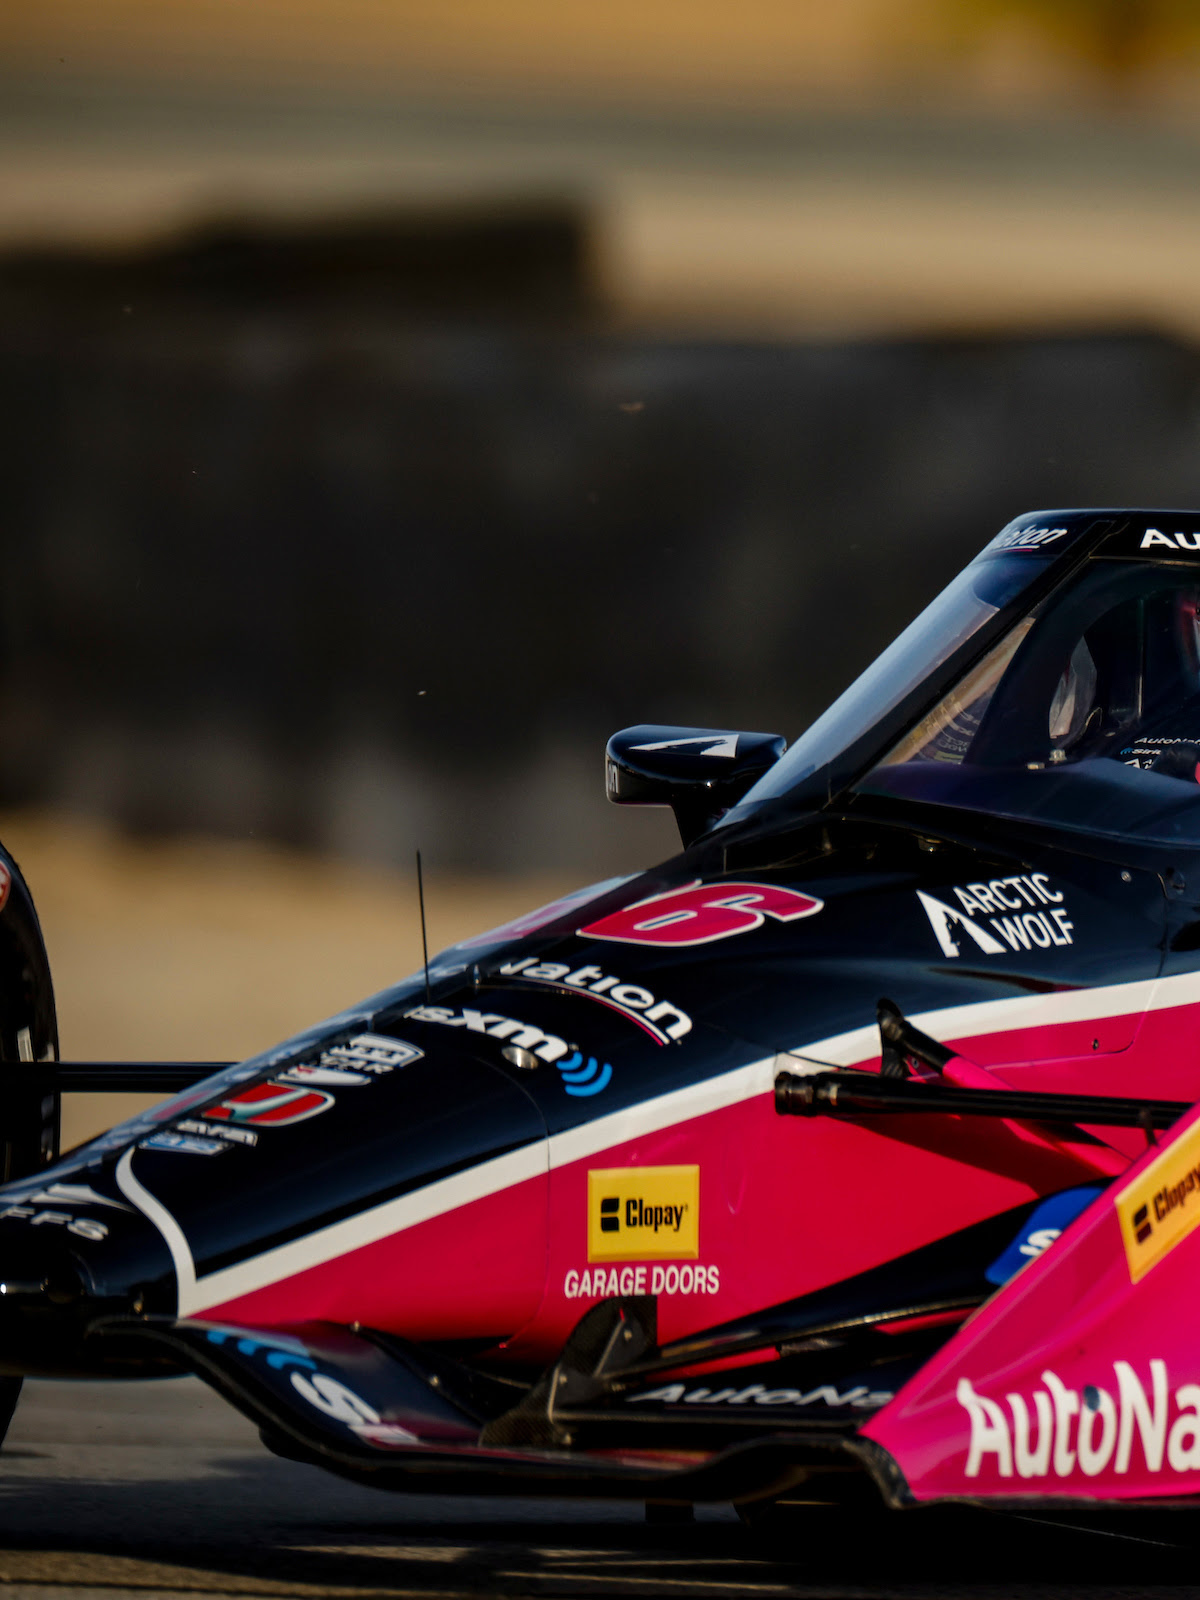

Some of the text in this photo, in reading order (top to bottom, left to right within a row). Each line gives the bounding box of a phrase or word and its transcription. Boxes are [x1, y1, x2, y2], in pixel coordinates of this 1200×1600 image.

[953, 872, 1063, 916] ARCTIC
[989, 908, 1074, 952] WOLF
[625, 1199, 684, 1233] Clopay
[564, 1265, 720, 1298] GARAGE DOORS
